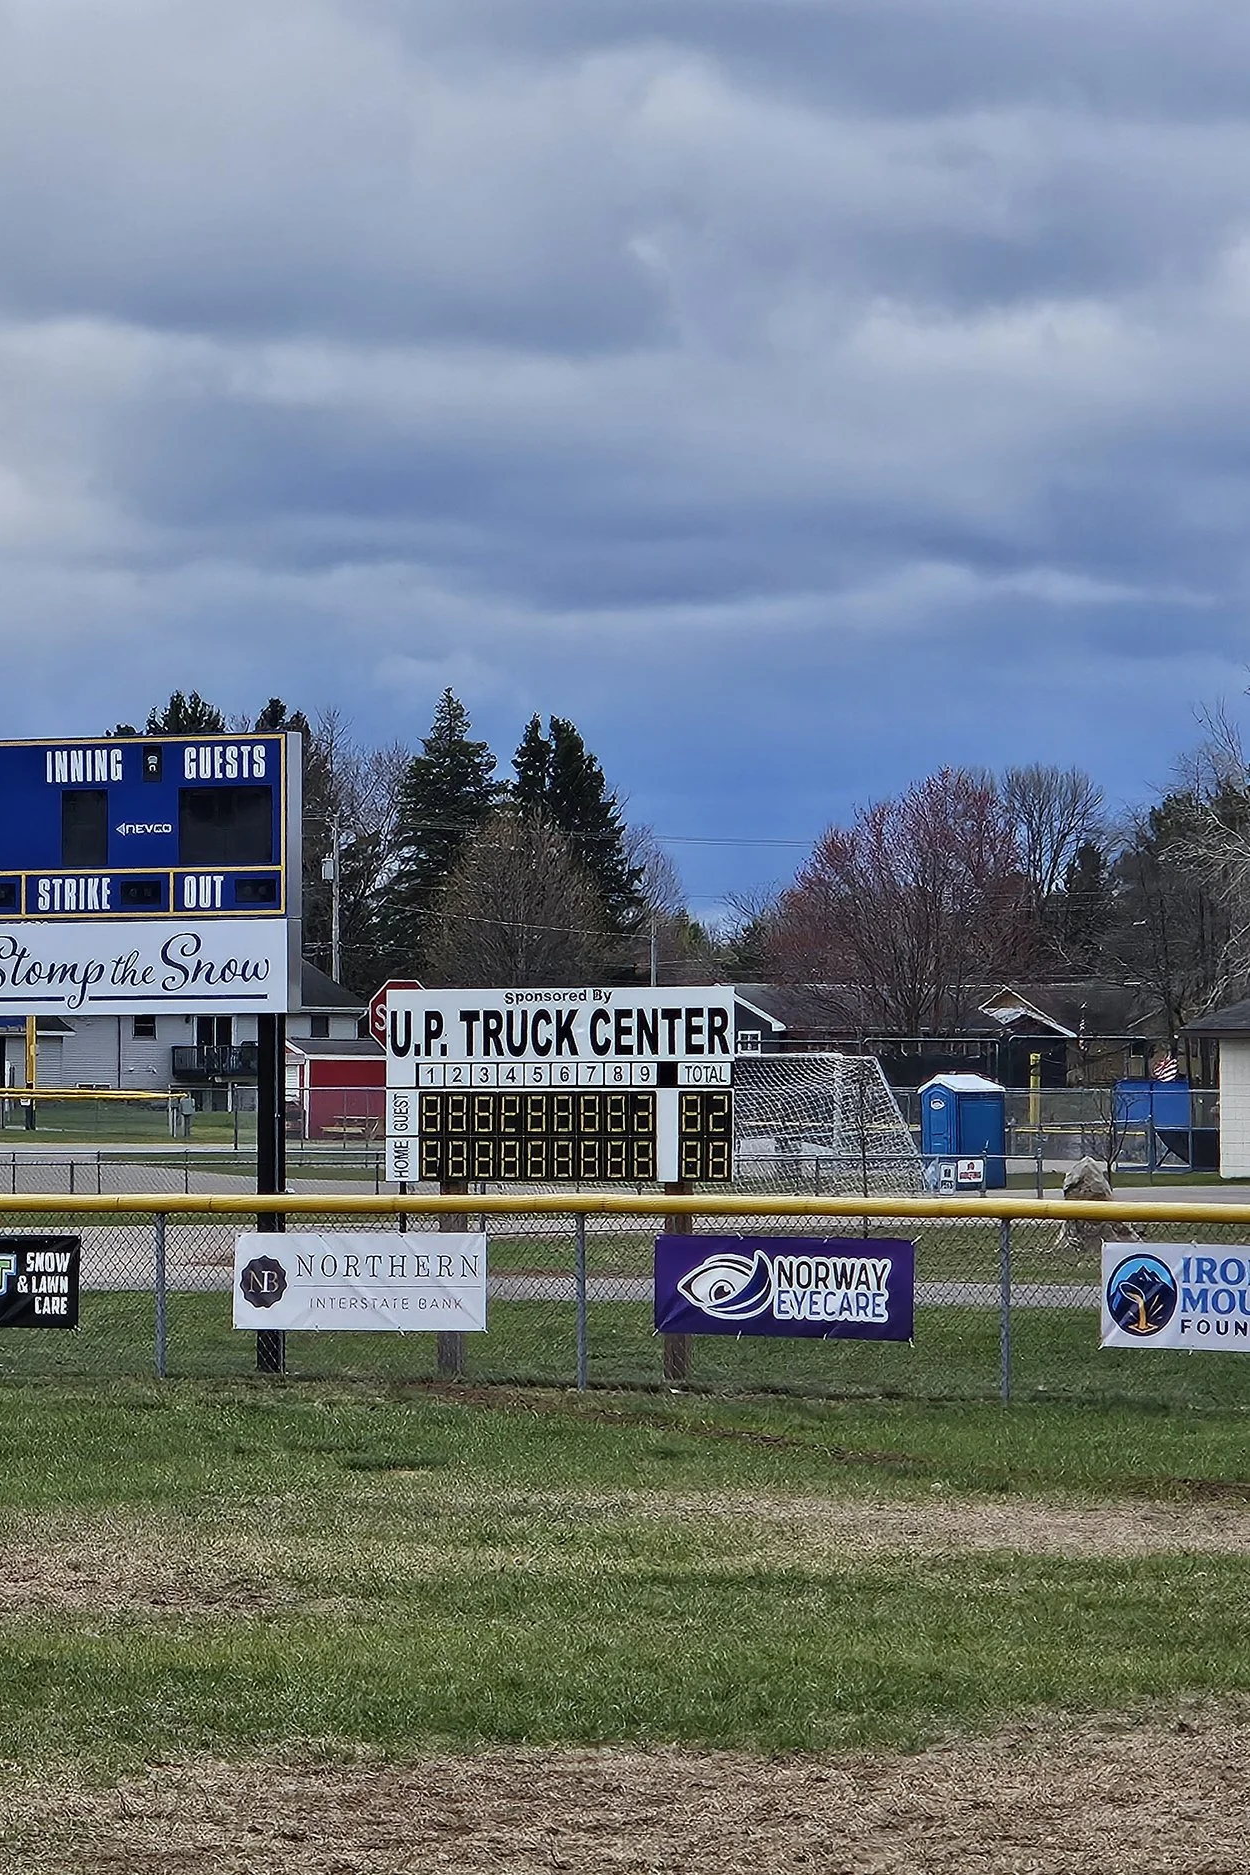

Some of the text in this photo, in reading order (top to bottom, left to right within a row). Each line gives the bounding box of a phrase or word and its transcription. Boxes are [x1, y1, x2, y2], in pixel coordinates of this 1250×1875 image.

[46, 749, 124, 783] INNING
[184, 744, 267, 780] GUESTS
[37, 877, 111, 912] STRIKE
[183, 874, 225, 908] OUT
[110, 949, 156, 986] the
[160, 932, 271, 992] Snow
[504, 988, 613, 1006] Sponsored By
[391, 1010, 448, 1058] U.P.
[459, 1008, 579, 1057] TRUCK
[589, 1006, 730, 1057] CENTER
[451, 1066, 463, 1083] 2
[478, 1066, 490, 1083] 3
[505, 1066, 517, 1083] 4
[532, 1066, 544, 1083] 5
[559, 1066, 571, 1083] 6
[586, 1066, 597, 1083] 7
[613, 1066, 624, 1083] 8
[639, 1066, 651, 1083] 9
[685, 1065, 727, 1084] TOTAL
[393, 1093, 409, 1132] GUEST
[393, 1140, 409, 1178] HOME
[26, 1252, 70, 1272] SNOW
[295, 1254, 479, 1278] NORTHERN
[777, 1260, 889, 1291] NORWAY
[1182, 1257, 1250, 1285] IRO
[17, 1275, 69, 1293] & LAWN
[35, 1296, 68, 1315] CARE
[310, 1297, 464, 1310] INTERSTATE BANK
[777, 1290, 885, 1318] EYECARE
